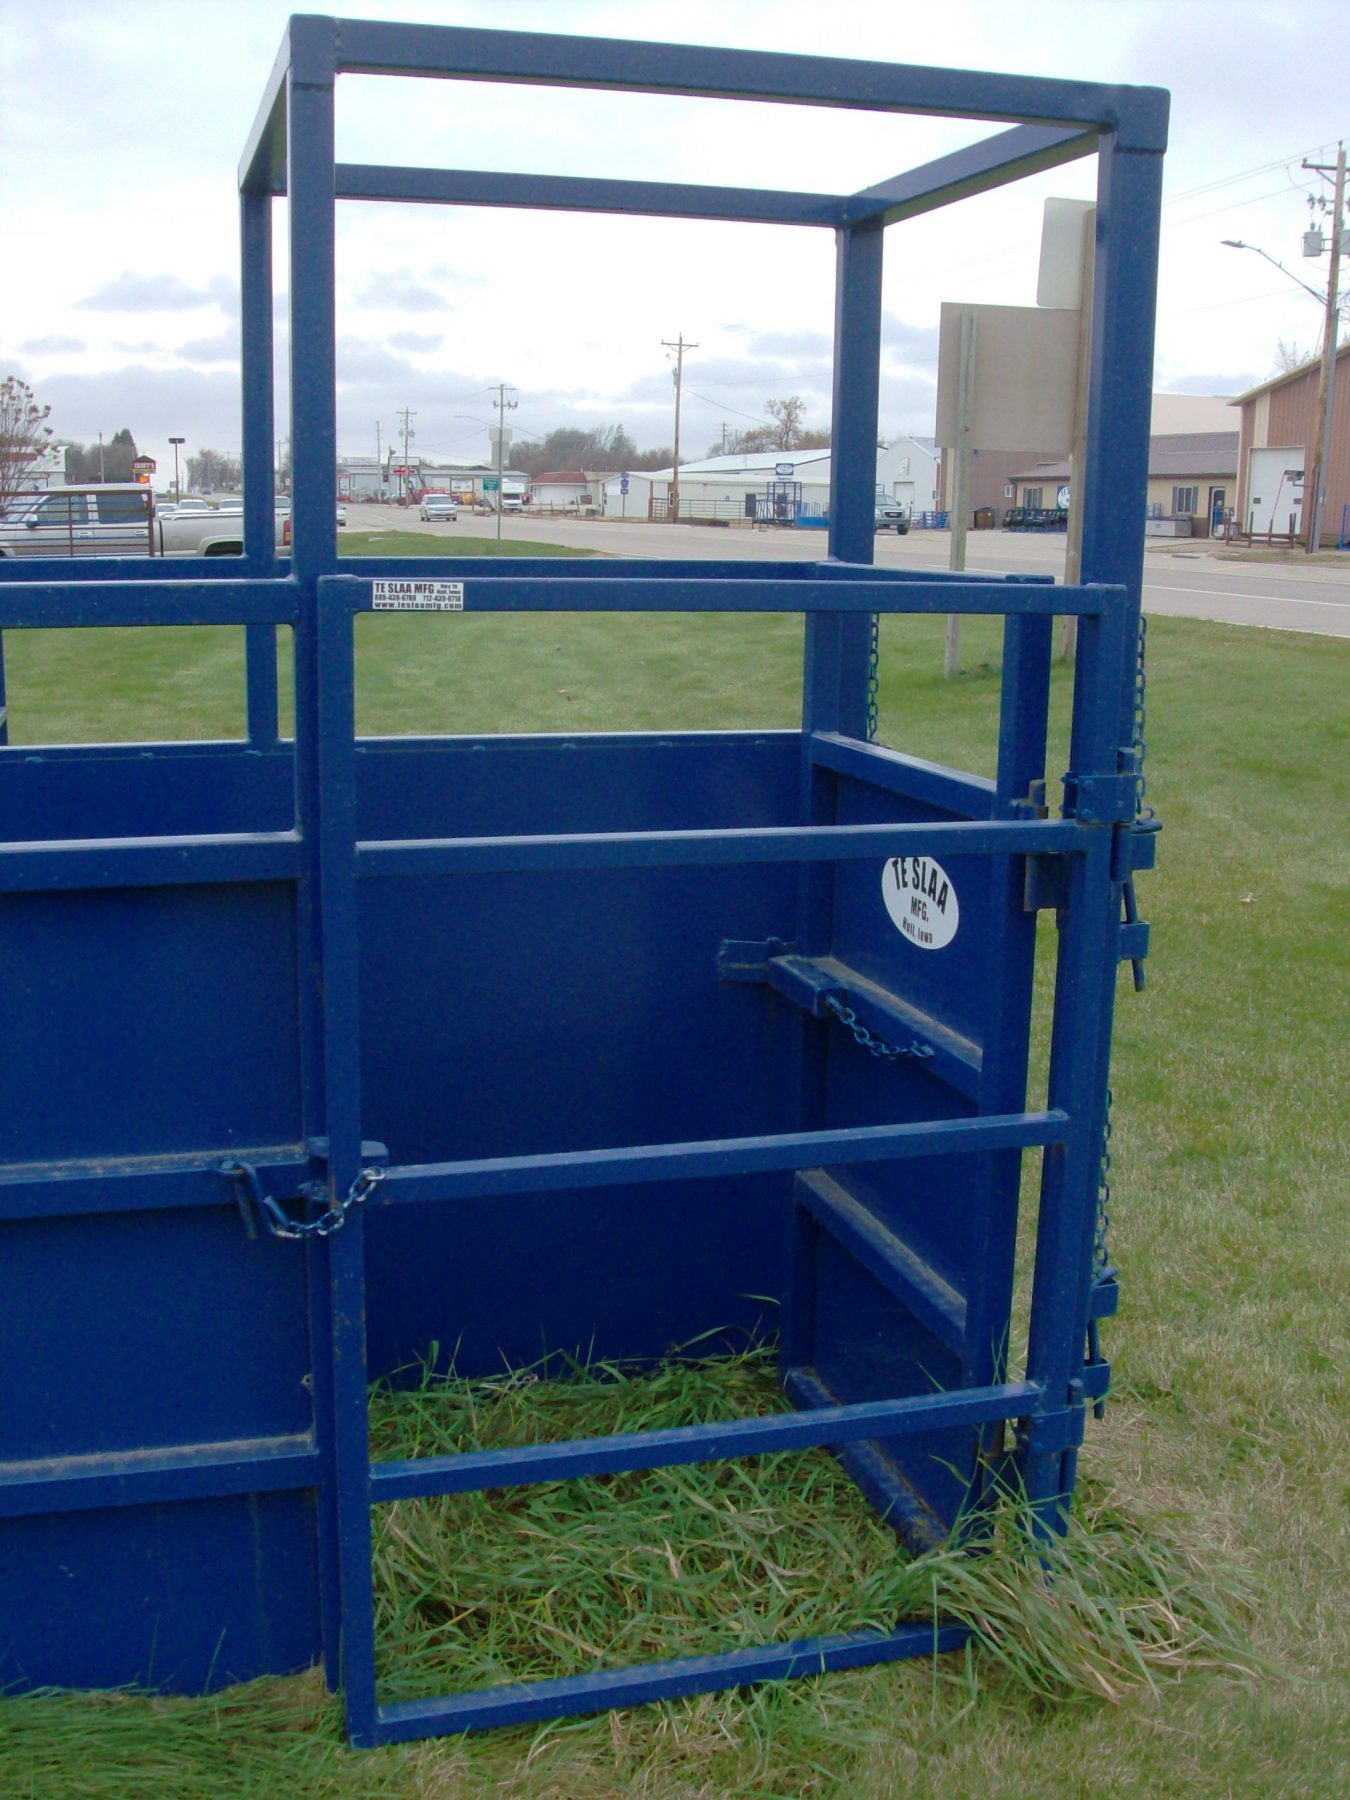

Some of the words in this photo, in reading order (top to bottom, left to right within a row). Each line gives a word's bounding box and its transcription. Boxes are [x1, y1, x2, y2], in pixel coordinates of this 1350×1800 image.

[388, 583, 412, 594] SLAA
[414, 583, 434, 594] MFG
[892, 857, 908, 890] TE
[912, 857, 949, 915] SLAA
[911, 896, 929, 922] MFG.
[918, 927, 933, 944] Iowa
